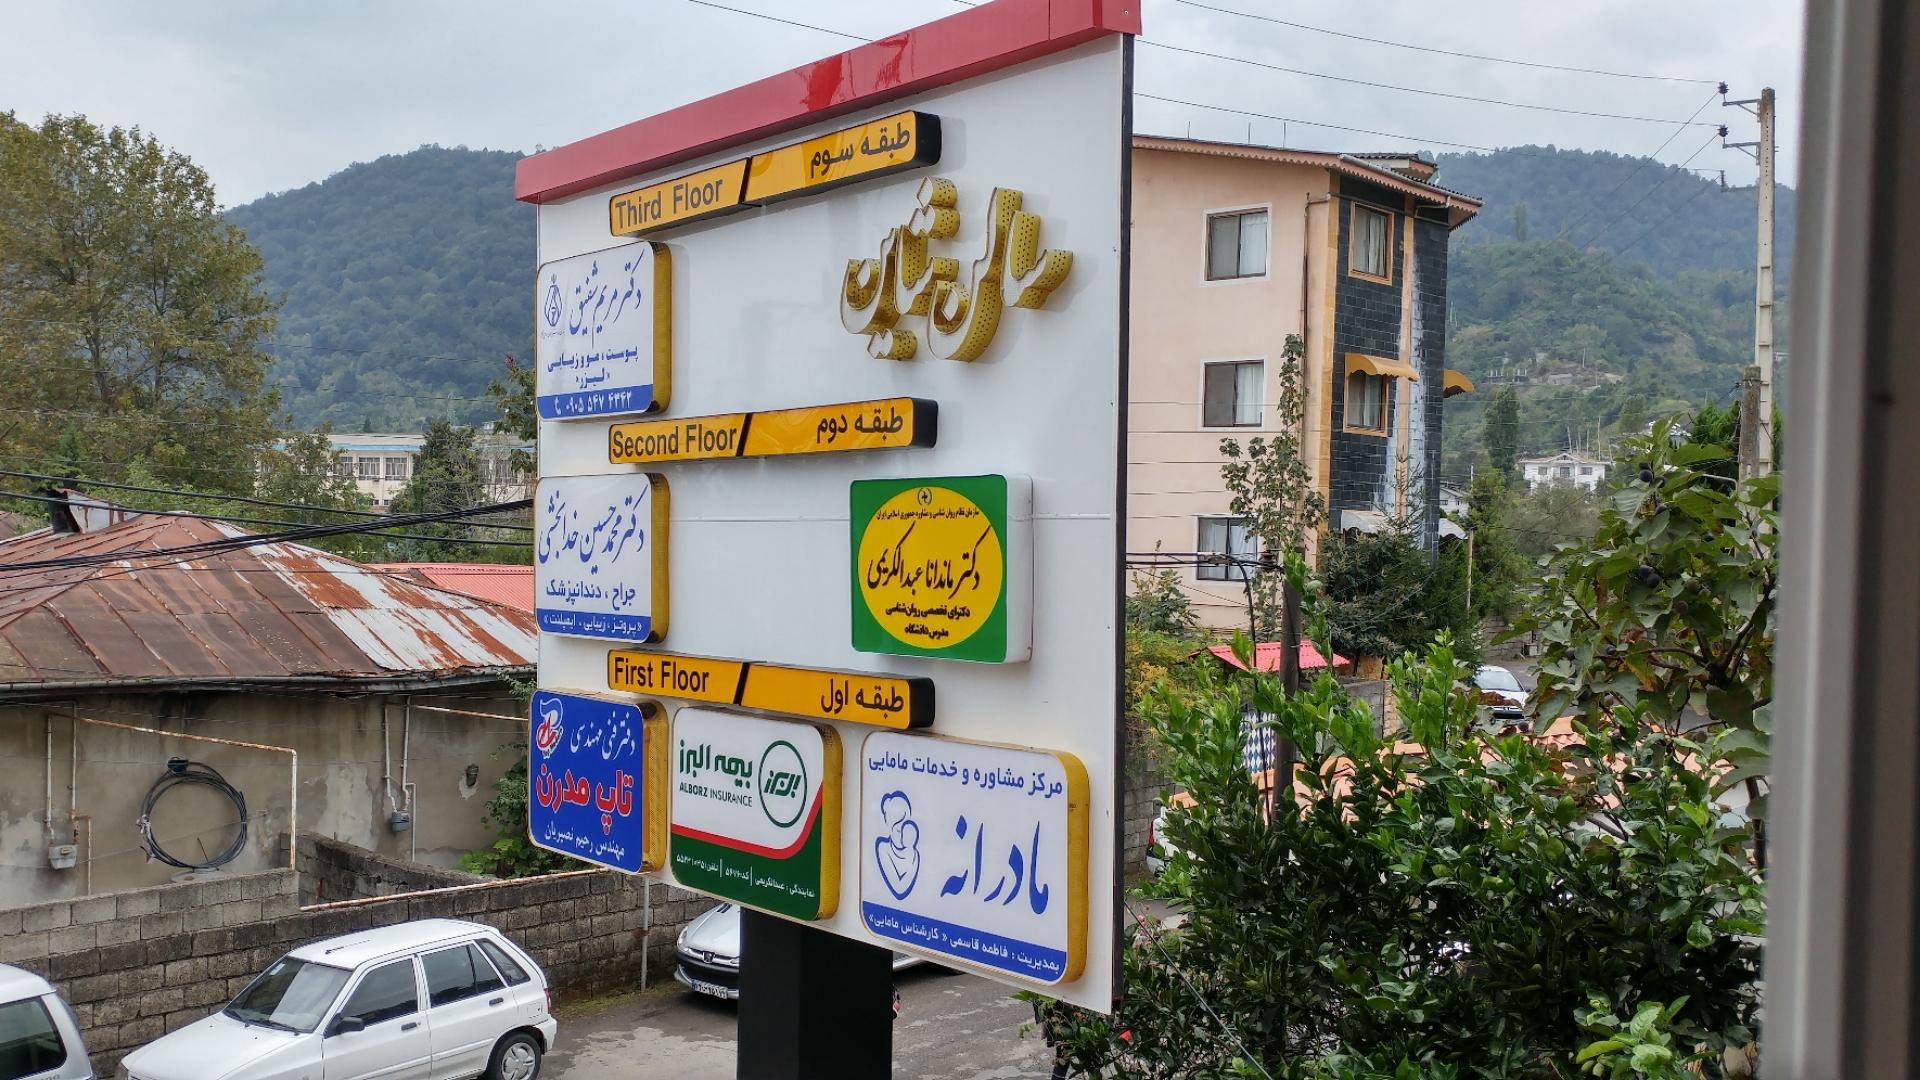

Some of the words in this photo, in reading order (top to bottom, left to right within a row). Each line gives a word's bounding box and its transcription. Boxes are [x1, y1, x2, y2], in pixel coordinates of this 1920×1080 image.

[860, 122, 911, 160] طبقه
[810, 143, 854, 178] سوم
[615, 199, 662, 229] Third
[672, 177, 723, 214] Floor
[613, 249, 645, 324] دکتر
[592, 284, 617, 349] مریم
[548, 352, 579, 372] زیبایی
[817, 412, 847, 444] دوم
[854, 406, 904, 442] طبقه
[613, 426, 679, 458] Second
[685, 424, 737, 453] Floor
[602, 515, 622, 554] محمد
[612, 484, 648, 563] دکتر
[580, 506, 616, 575] حسین
[925, 559, 953, 589] ماندانا
[948, 524, 991, 600] دکتر
[546, 578, 602, 605] دندانپزشک
[612, 582, 636, 611] جراح
[904, 622, 929, 635] دانشگاه
[947, 605, 970, 620] دکترای
[928, 627, 949, 640] مدرس
[614, 657, 654, 687] First
[660, 661, 710, 693] Floor
[821, 678, 849, 715] اول
[855, 686, 904, 720] طبقه
[570, 722, 603, 754] مهندسی
[612, 712, 636, 760] دفتر
[680, 739, 711, 778] البرز
[715, 755, 752, 789] بیمه
[868, 751, 908, 772] مامایی
[912, 757, 958, 777] خدمات
[536, 763, 590, 814] مدرن
[962, 769, 969, 784] و
[973, 768, 1024, 789] مشاوره
[1028, 772, 1063, 799] مرکز
[596, 769, 634, 835] تاپ
[680, 782, 707, 798] ALBORZ
[710, 788, 753, 808] INSURANCE
[545, 821, 574, 843] نصیریان
[576, 835, 593, 854] رحیم
[595, 839, 625, 861] مهندس
[940, 815, 1049, 915] مادرانه
[901, 922, 939, 941] کارشناس
[950, 937, 979, 950] قاسمی
[982, 945, 1009, 959] فاطمه
[1017, 951, 1060, 975] بمدیریت
